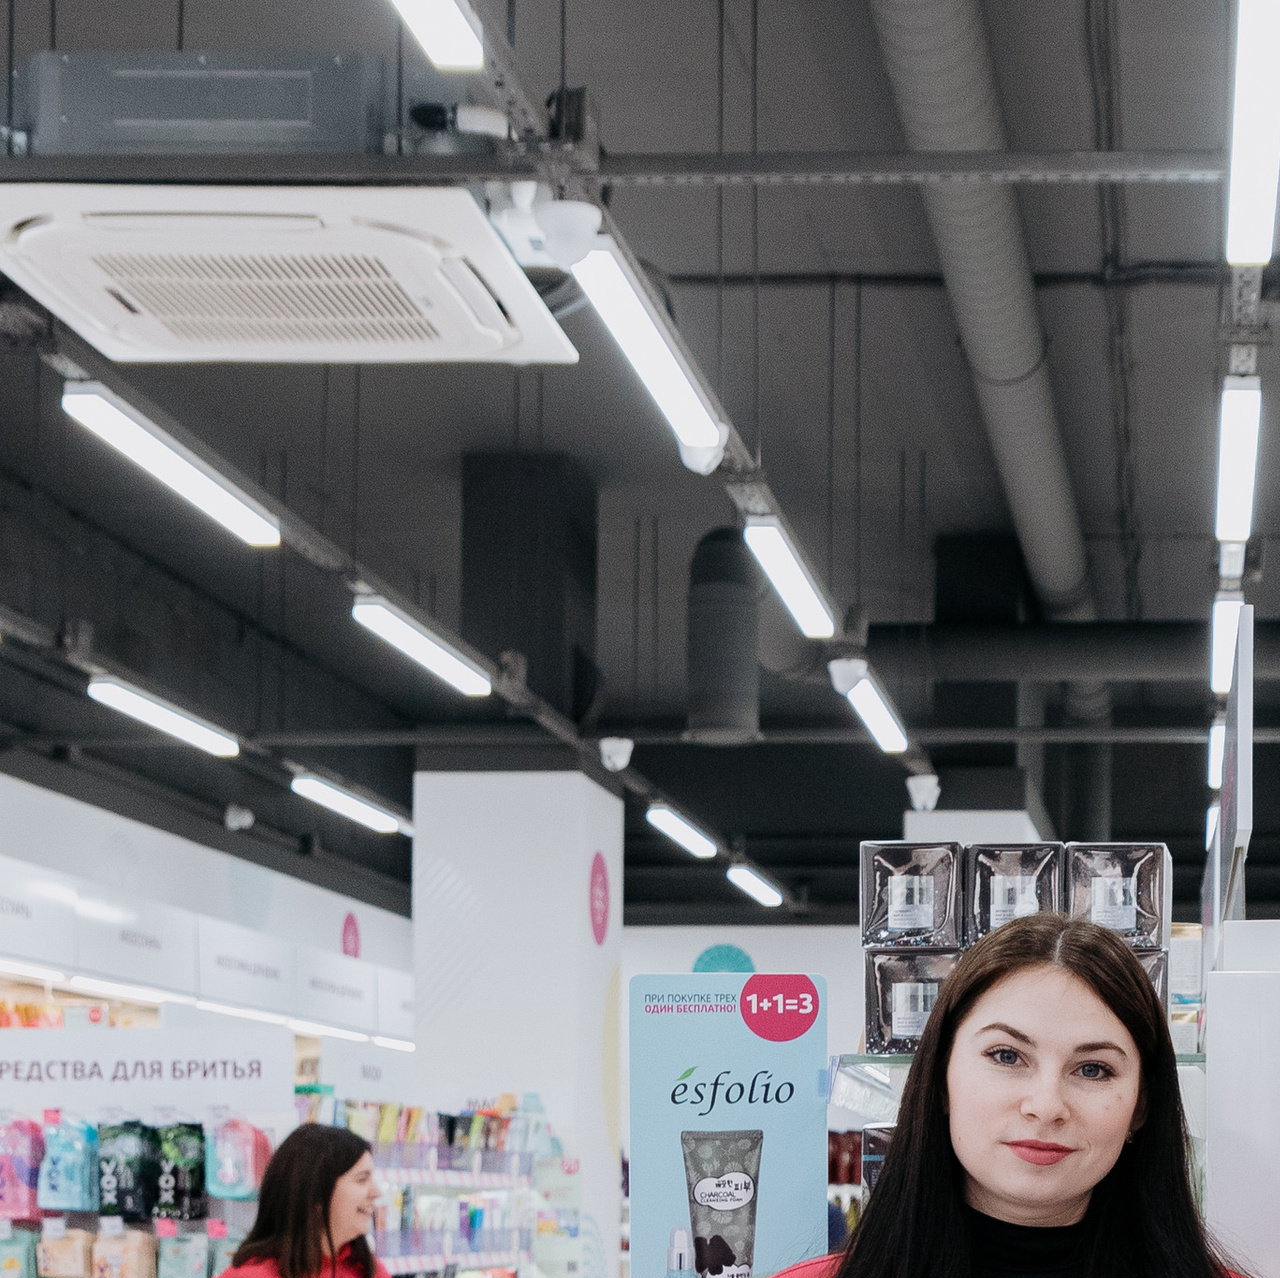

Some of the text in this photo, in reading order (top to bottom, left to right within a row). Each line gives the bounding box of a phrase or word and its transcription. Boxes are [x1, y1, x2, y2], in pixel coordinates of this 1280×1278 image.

[645, 994, 736, 1003] ПРИ ПОКУПКЕ ТРЕХ
[746, 993, 813, 1014] 1+1=3
[645, 1004, 736, 1014] ОДИН БЕСПЛАТНО!
[112, 1061, 162, 1081] ДЛЯ
[172, 1061, 262, 1080] БРИТЬЯ
